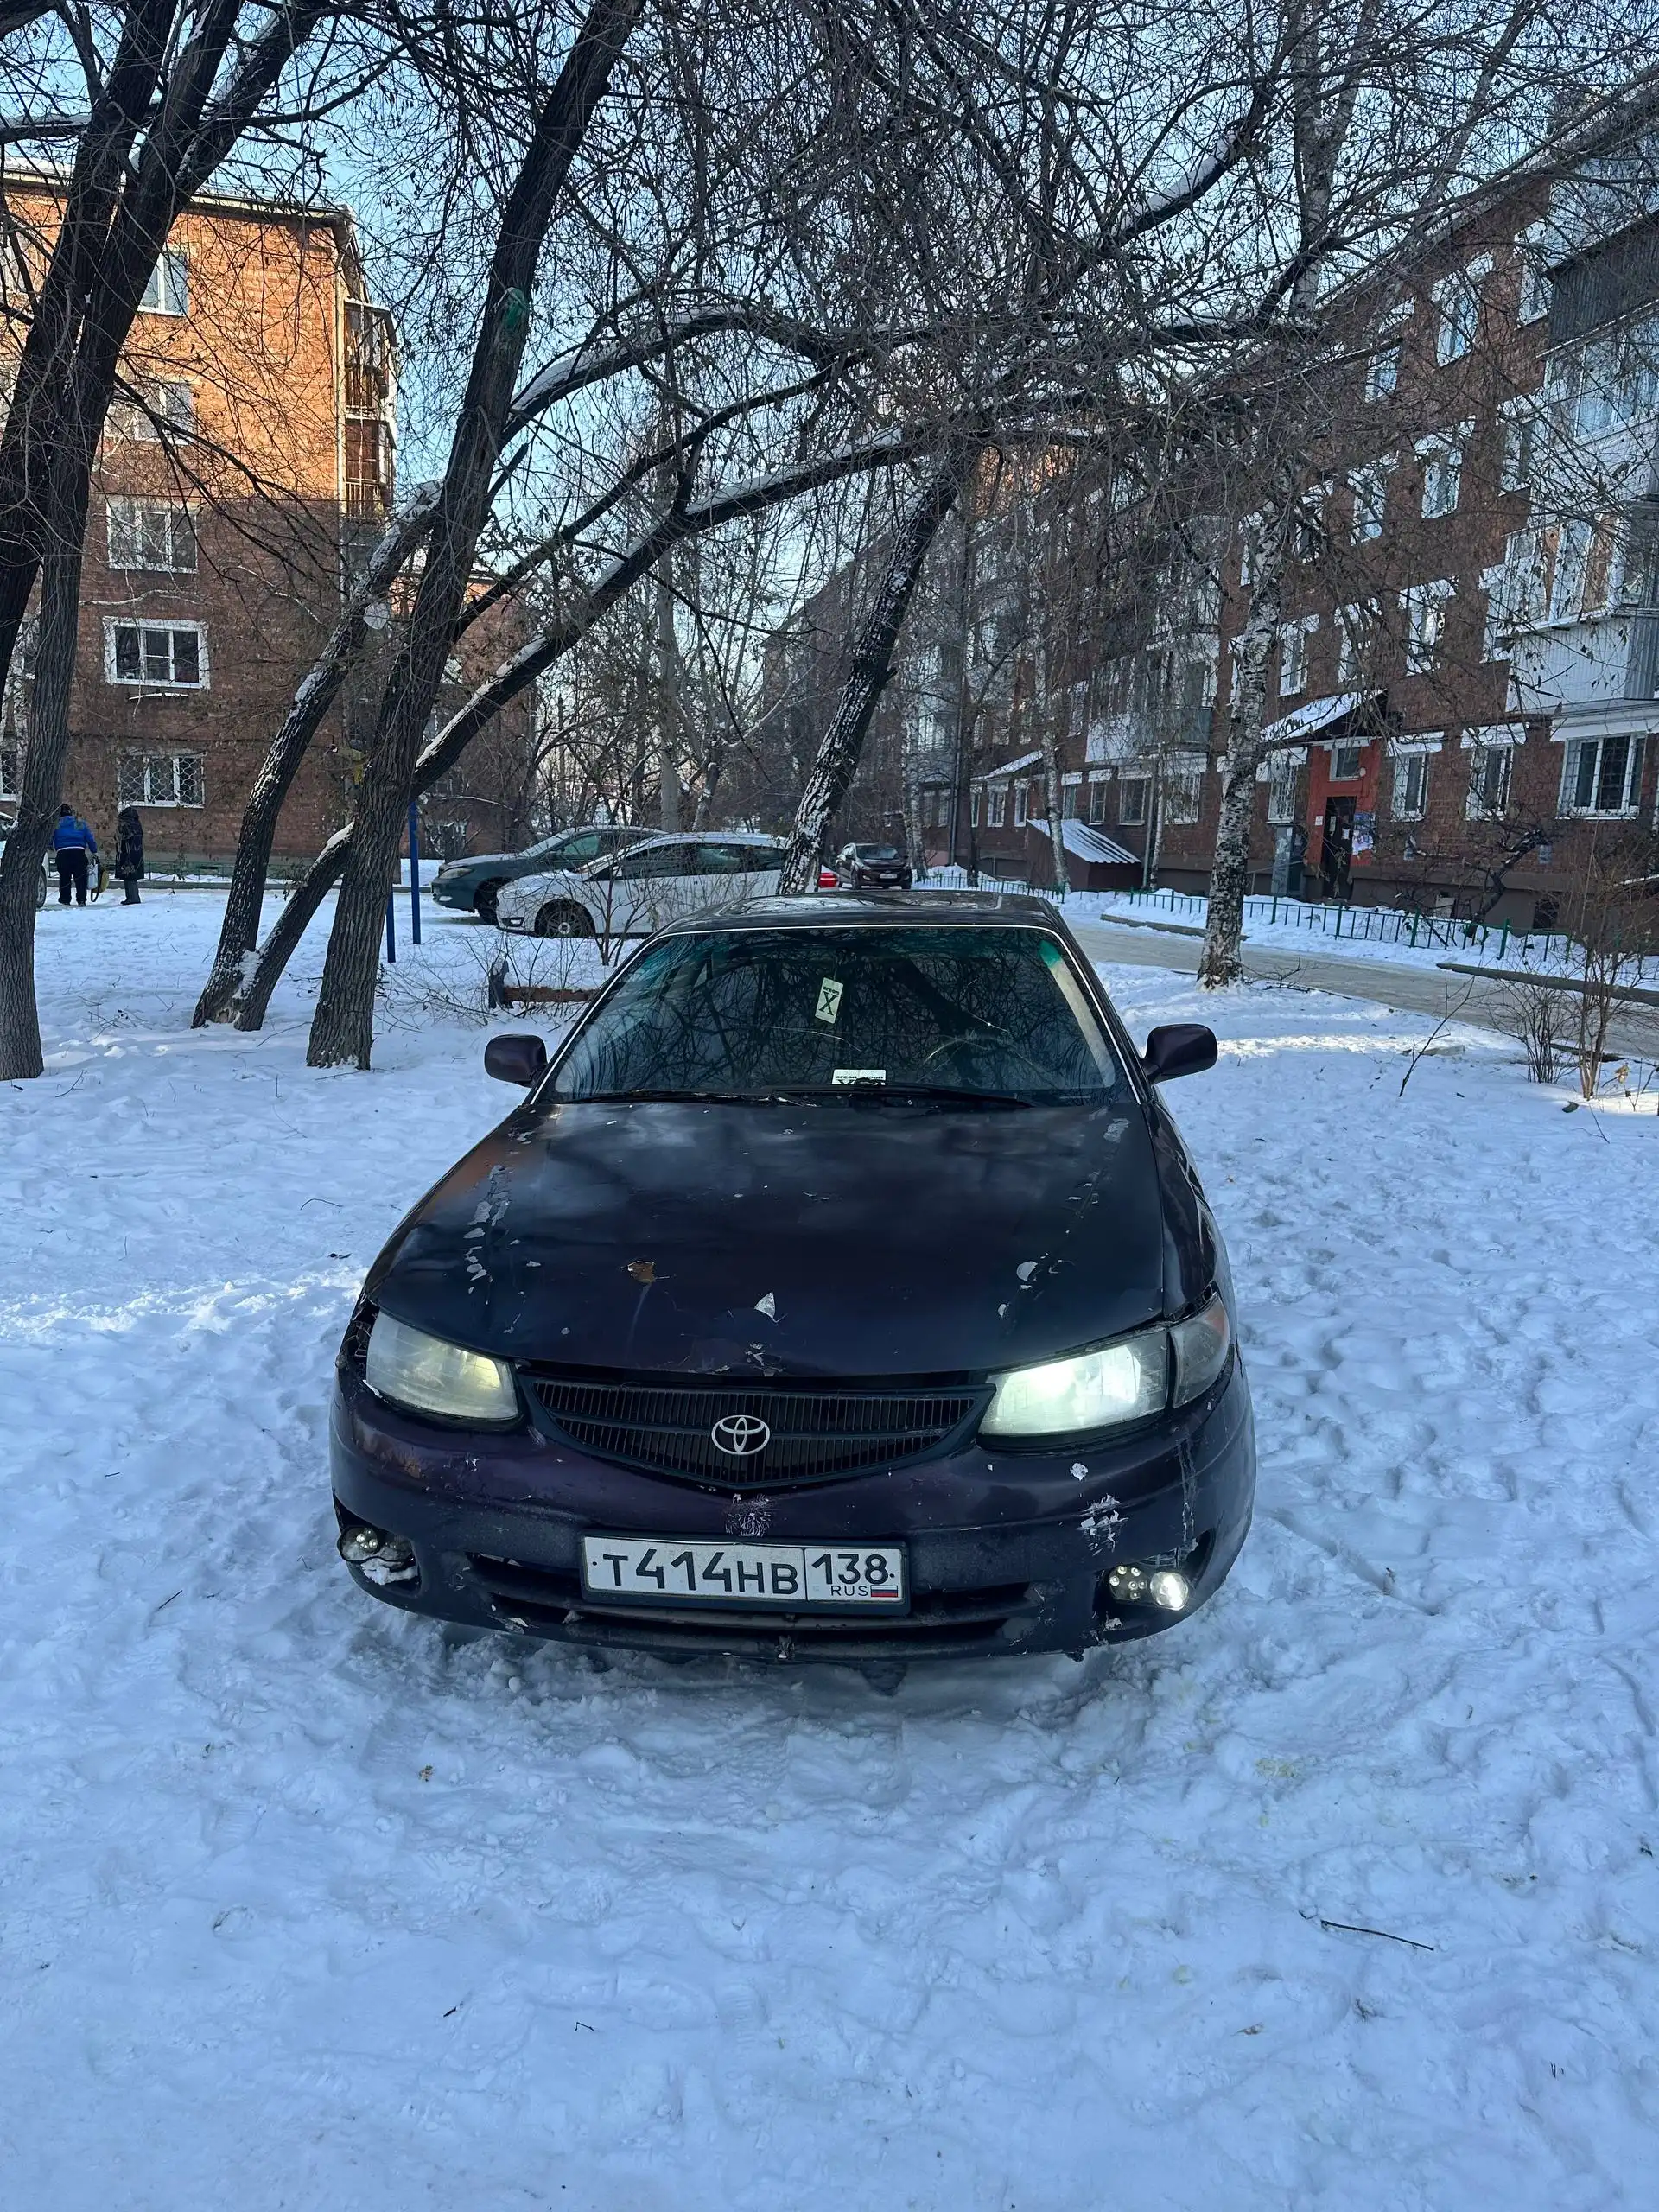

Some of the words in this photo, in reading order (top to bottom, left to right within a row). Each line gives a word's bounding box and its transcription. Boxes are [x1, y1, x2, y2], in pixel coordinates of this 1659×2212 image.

[818, 990, 839, 1016] X
[602, 1548, 798, 1595] Т414НВ
[811, 1553, 889, 1586] 138
[830, 1585, 868, 1597] RUS
